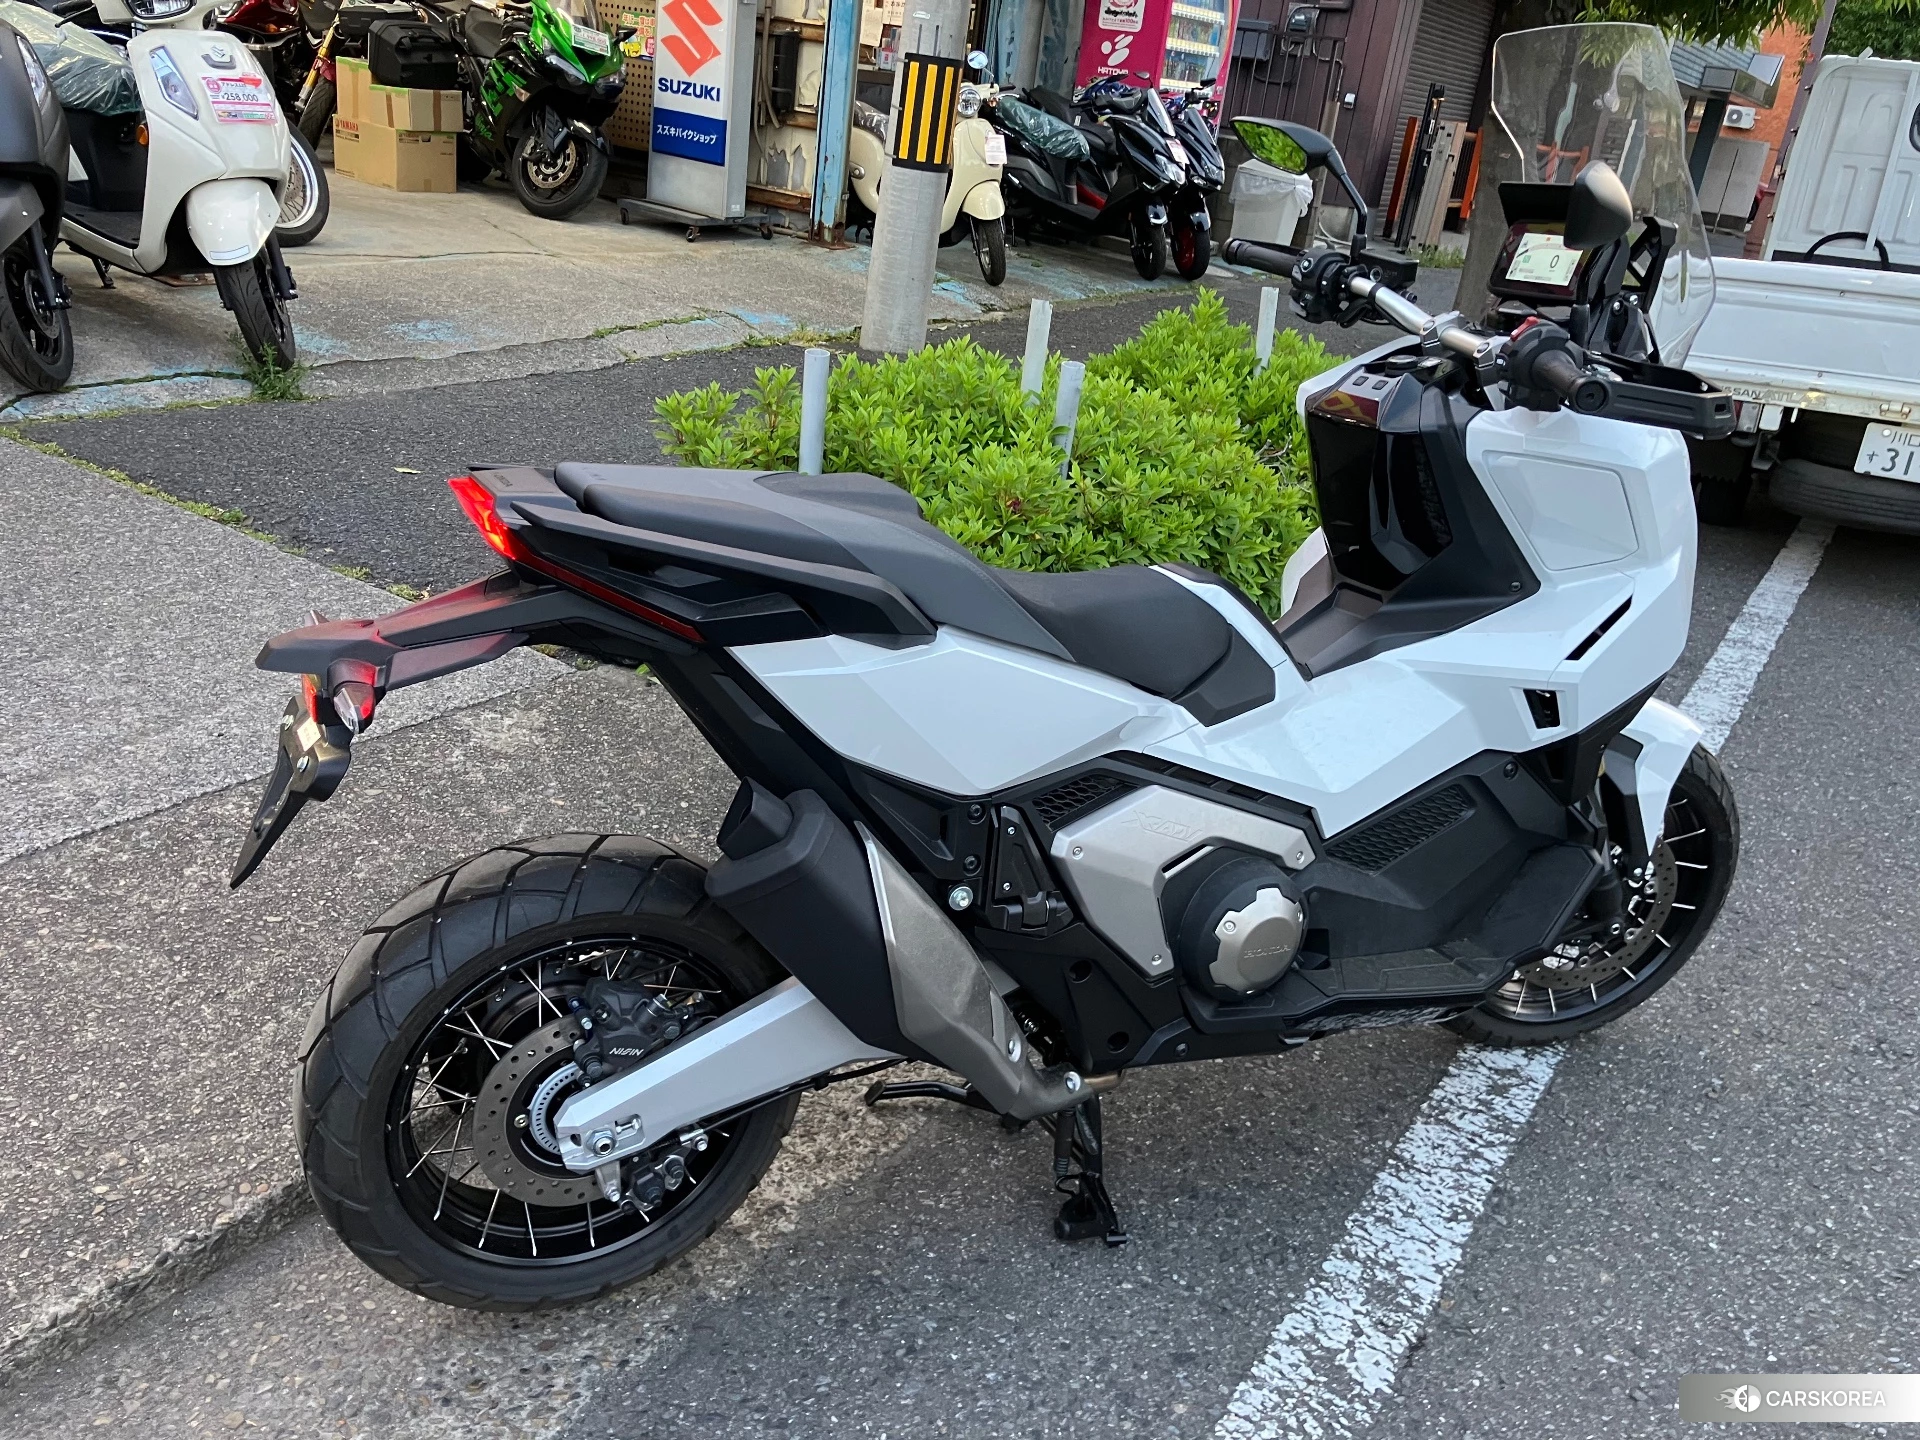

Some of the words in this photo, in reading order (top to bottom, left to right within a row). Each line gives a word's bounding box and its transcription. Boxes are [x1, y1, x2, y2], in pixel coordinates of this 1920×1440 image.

[658, 77, 721, 102] SUZUKI
[656, 124, 717, 145] スズキバイクショップ
